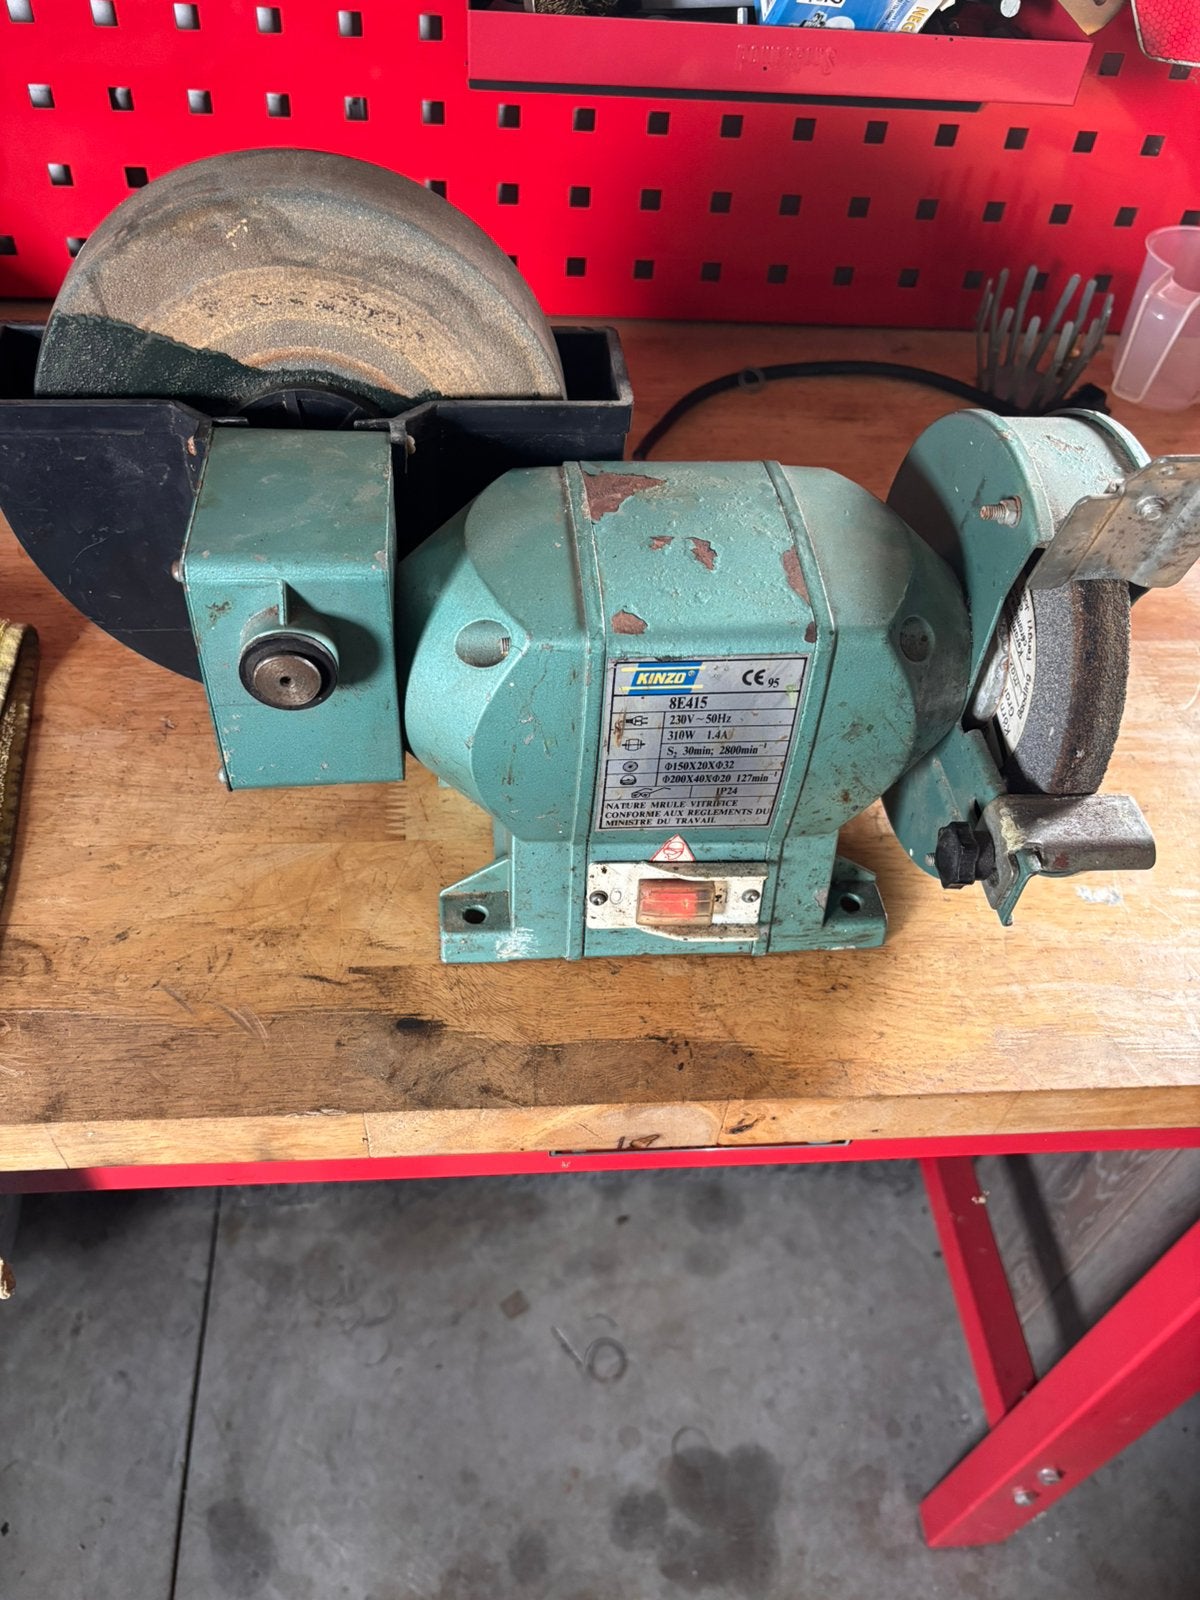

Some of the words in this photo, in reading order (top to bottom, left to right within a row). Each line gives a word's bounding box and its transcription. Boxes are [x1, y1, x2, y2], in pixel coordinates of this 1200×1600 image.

[768, 678, 780, 688] 95
[669, 696, 708, 709] 8E415
[667, 730, 695, 740] 310W
[707, 730, 728, 740] 1.4A
[716, 787, 738, 795] IP24
[606, 802, 646, 810] NATURE
[605, 811, 661, 819] CONFORME
[676, 817, 716, 825] TRAVAIL
